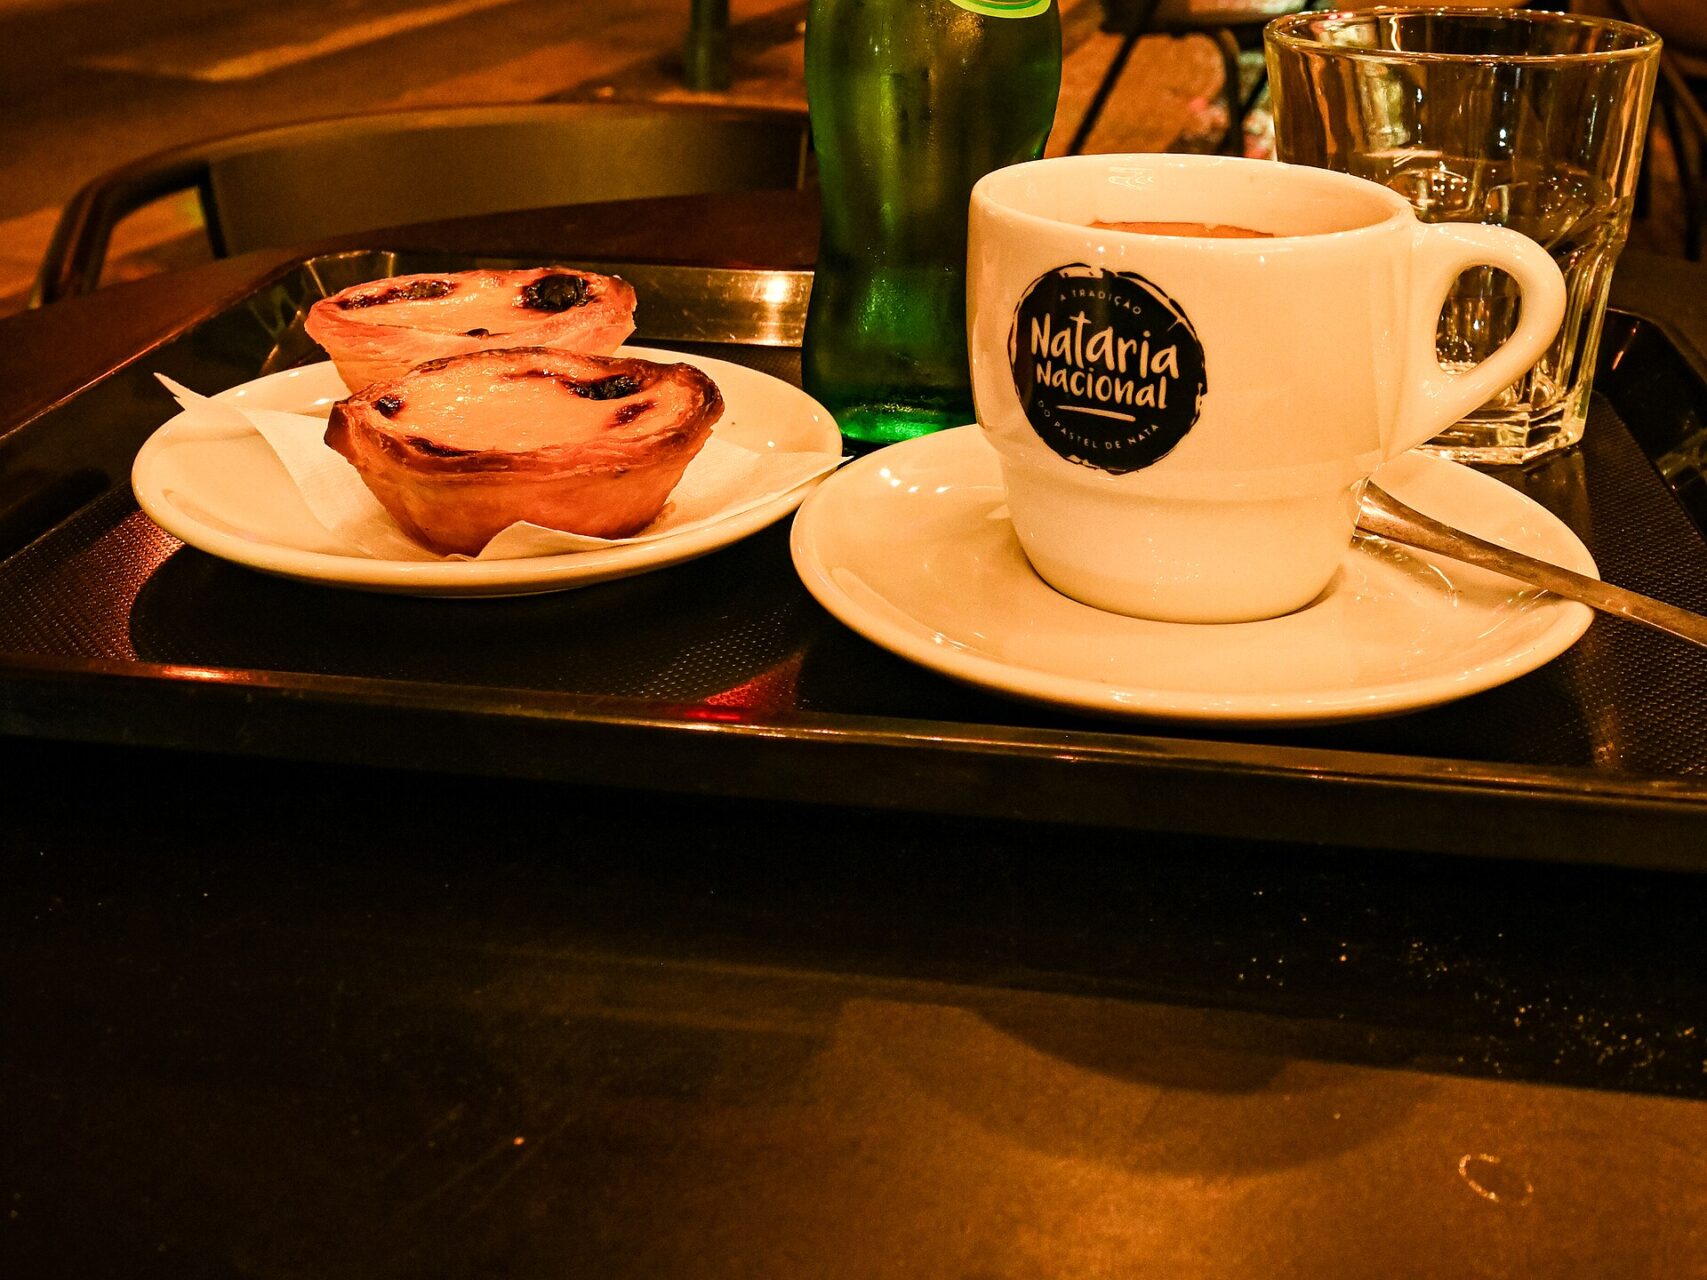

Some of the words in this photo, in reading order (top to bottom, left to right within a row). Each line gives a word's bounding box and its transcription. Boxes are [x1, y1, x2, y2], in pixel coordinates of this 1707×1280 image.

[1060, 293, 1067, 302] A
[1030, 310, 1180, 380] Nataria
[1036, 359, 1168, 410] Nacional
[1037, 399, 1051, 418] DO
[1053, 420, 1098, 449] PASTEL
[1104, 440, 1121, 450] DE
[1127, 423, 1160, 445] NATA
